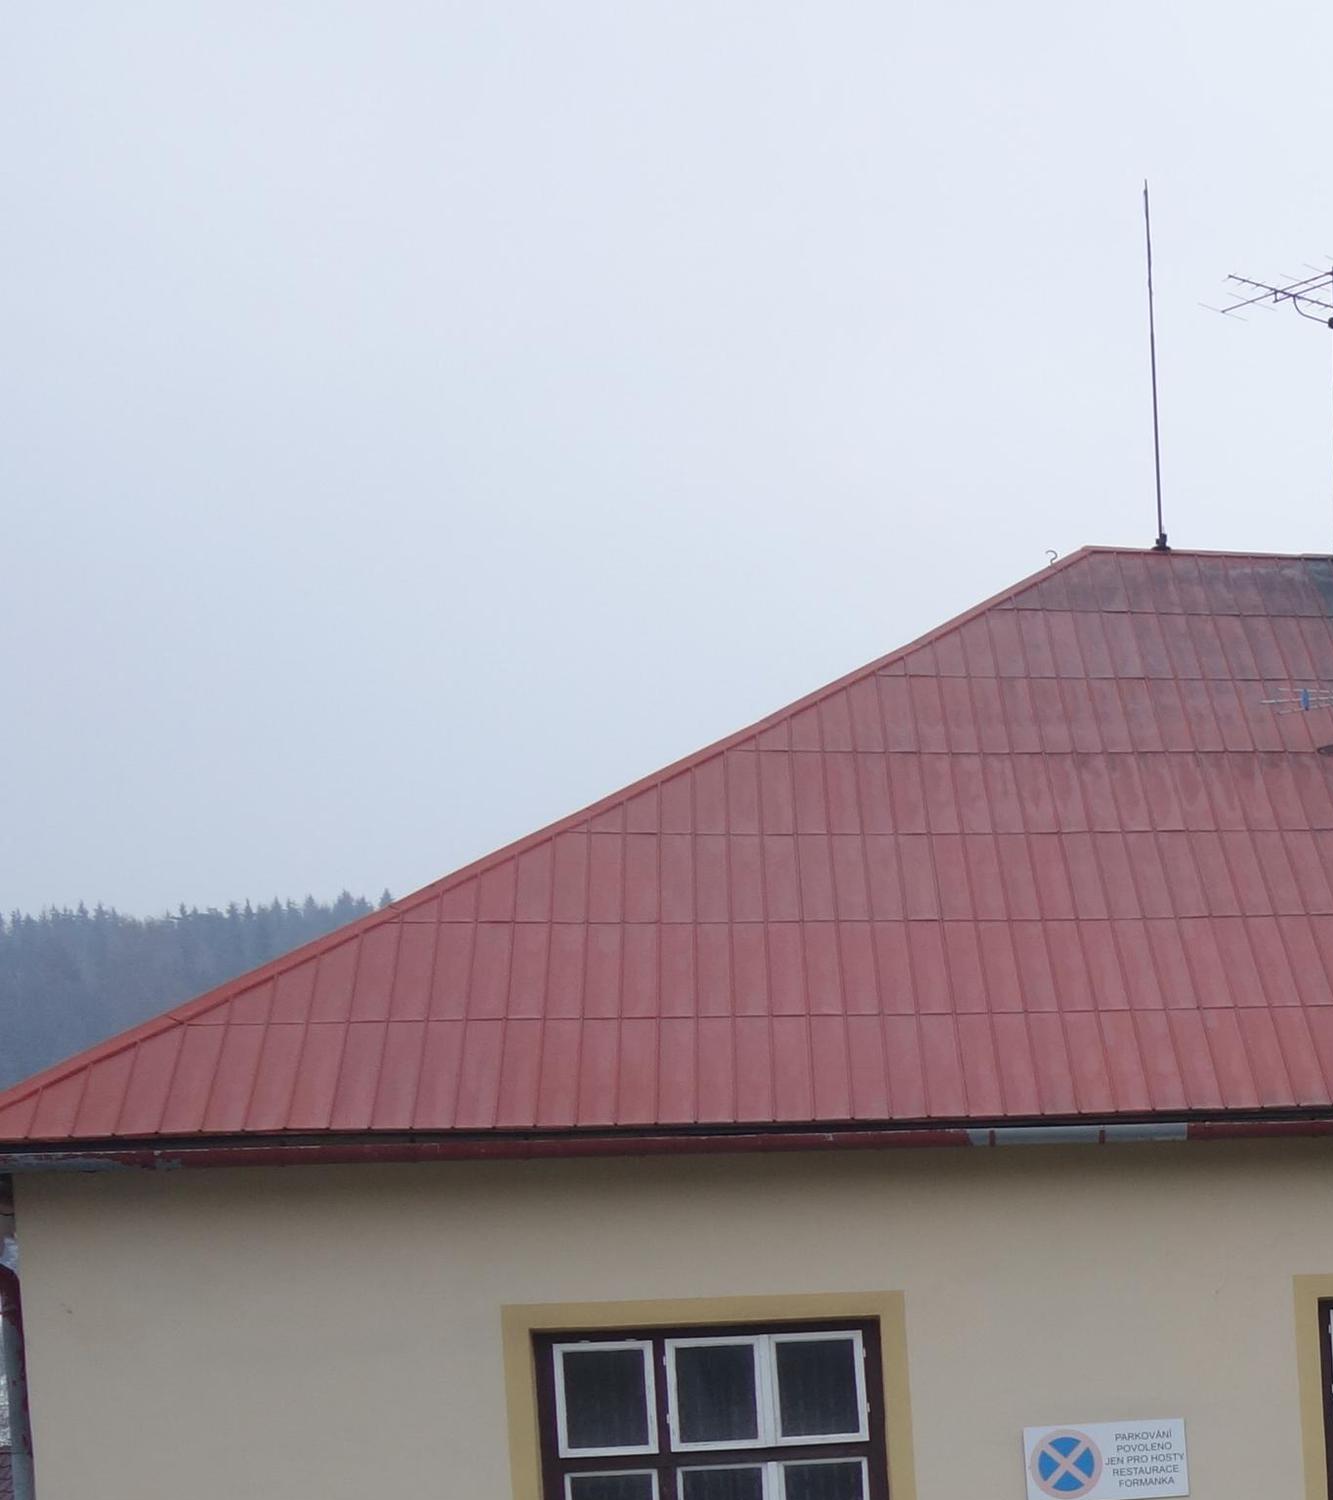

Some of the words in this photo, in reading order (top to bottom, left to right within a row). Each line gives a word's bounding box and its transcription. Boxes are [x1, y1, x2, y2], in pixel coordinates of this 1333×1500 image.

[1115, 1430, 1172, 1441] PARKOVÁNÍ
[1116, 1442, 1172, 1453] POVOLENO
[1105, 1457, 1124, 1466] JEN
[1127, 1455, 1149, 1464] PRO
[1151, 1453, 1184, 1463] HOSTY
[1112, 1465, 1179, 1476] RESTAURACE
[1119, 1477, 1175, 1488] FORMANKA
